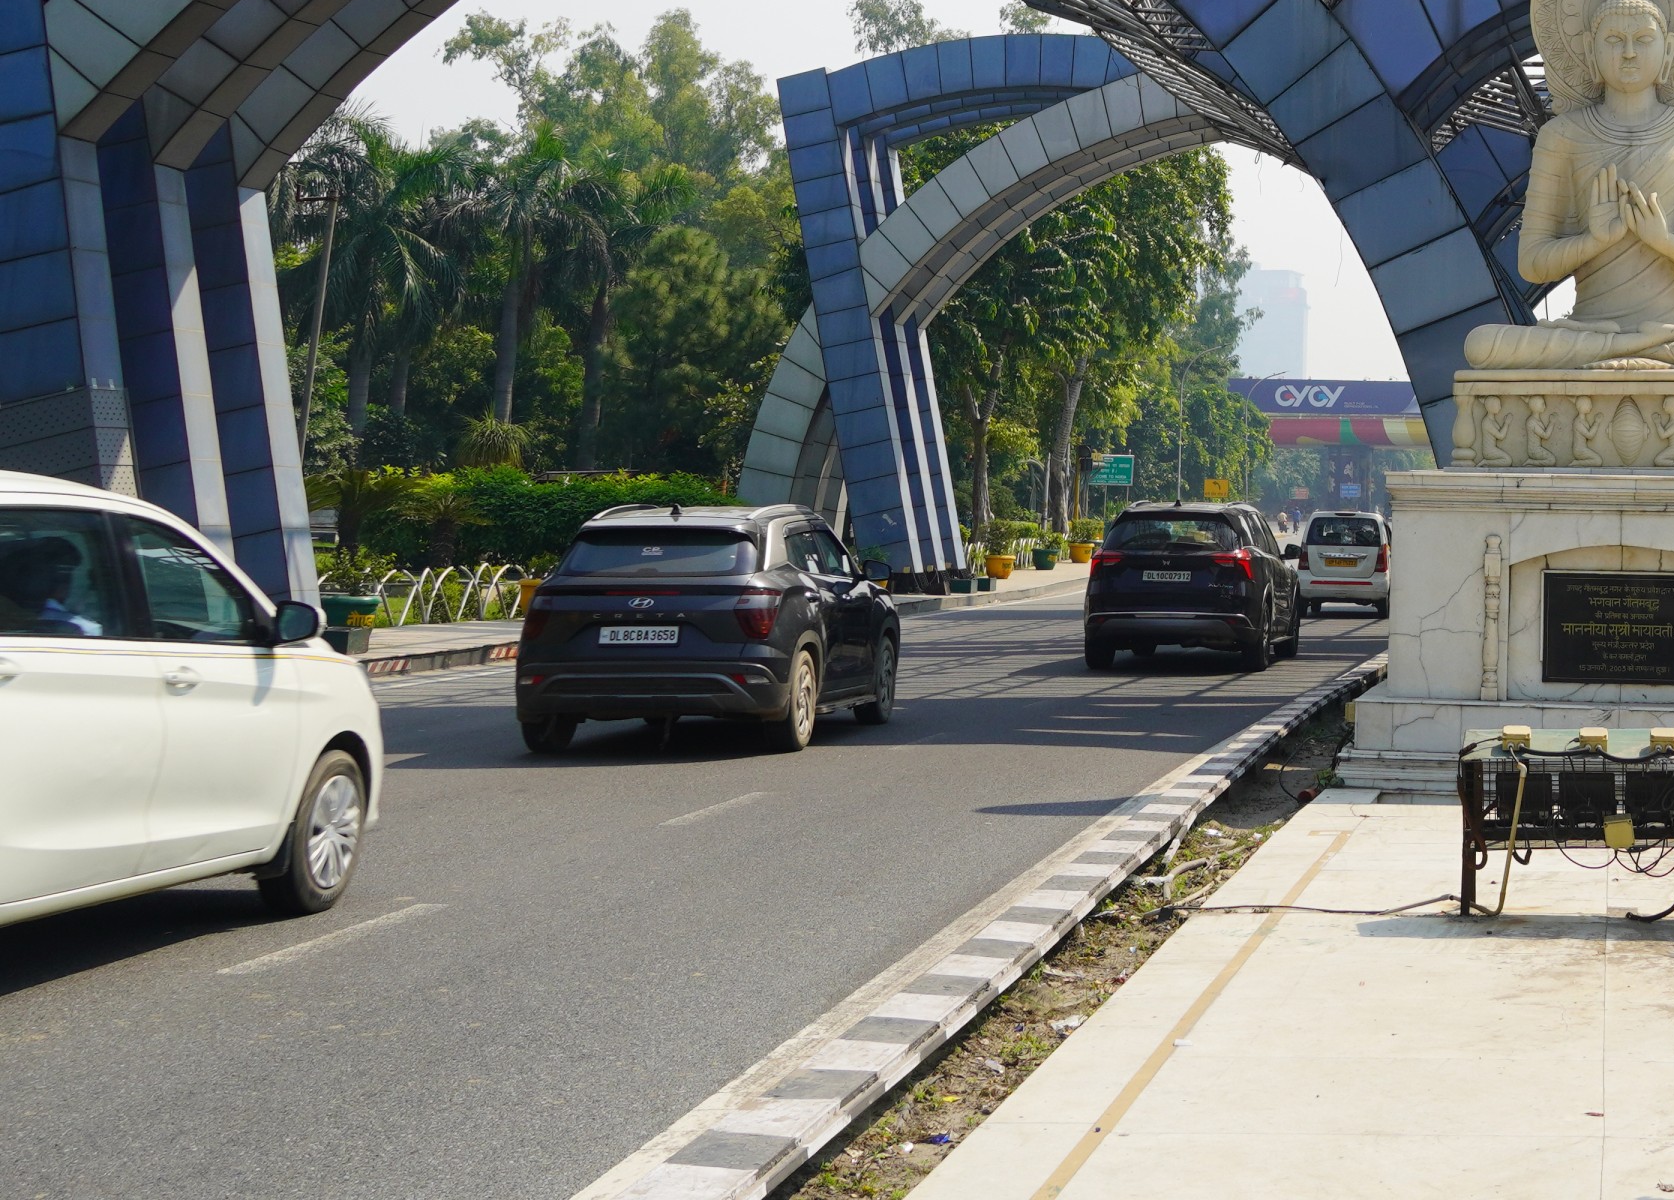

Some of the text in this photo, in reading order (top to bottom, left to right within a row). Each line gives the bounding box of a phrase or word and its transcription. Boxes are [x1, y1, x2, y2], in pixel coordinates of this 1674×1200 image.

[1588, 597, 1621, 607] भगवान
[609, 629, 676, 642] DL8CBA3658
[1561, 621, 1608, 636] माननीया
[1631, 622, 1674, 638] मायावती
